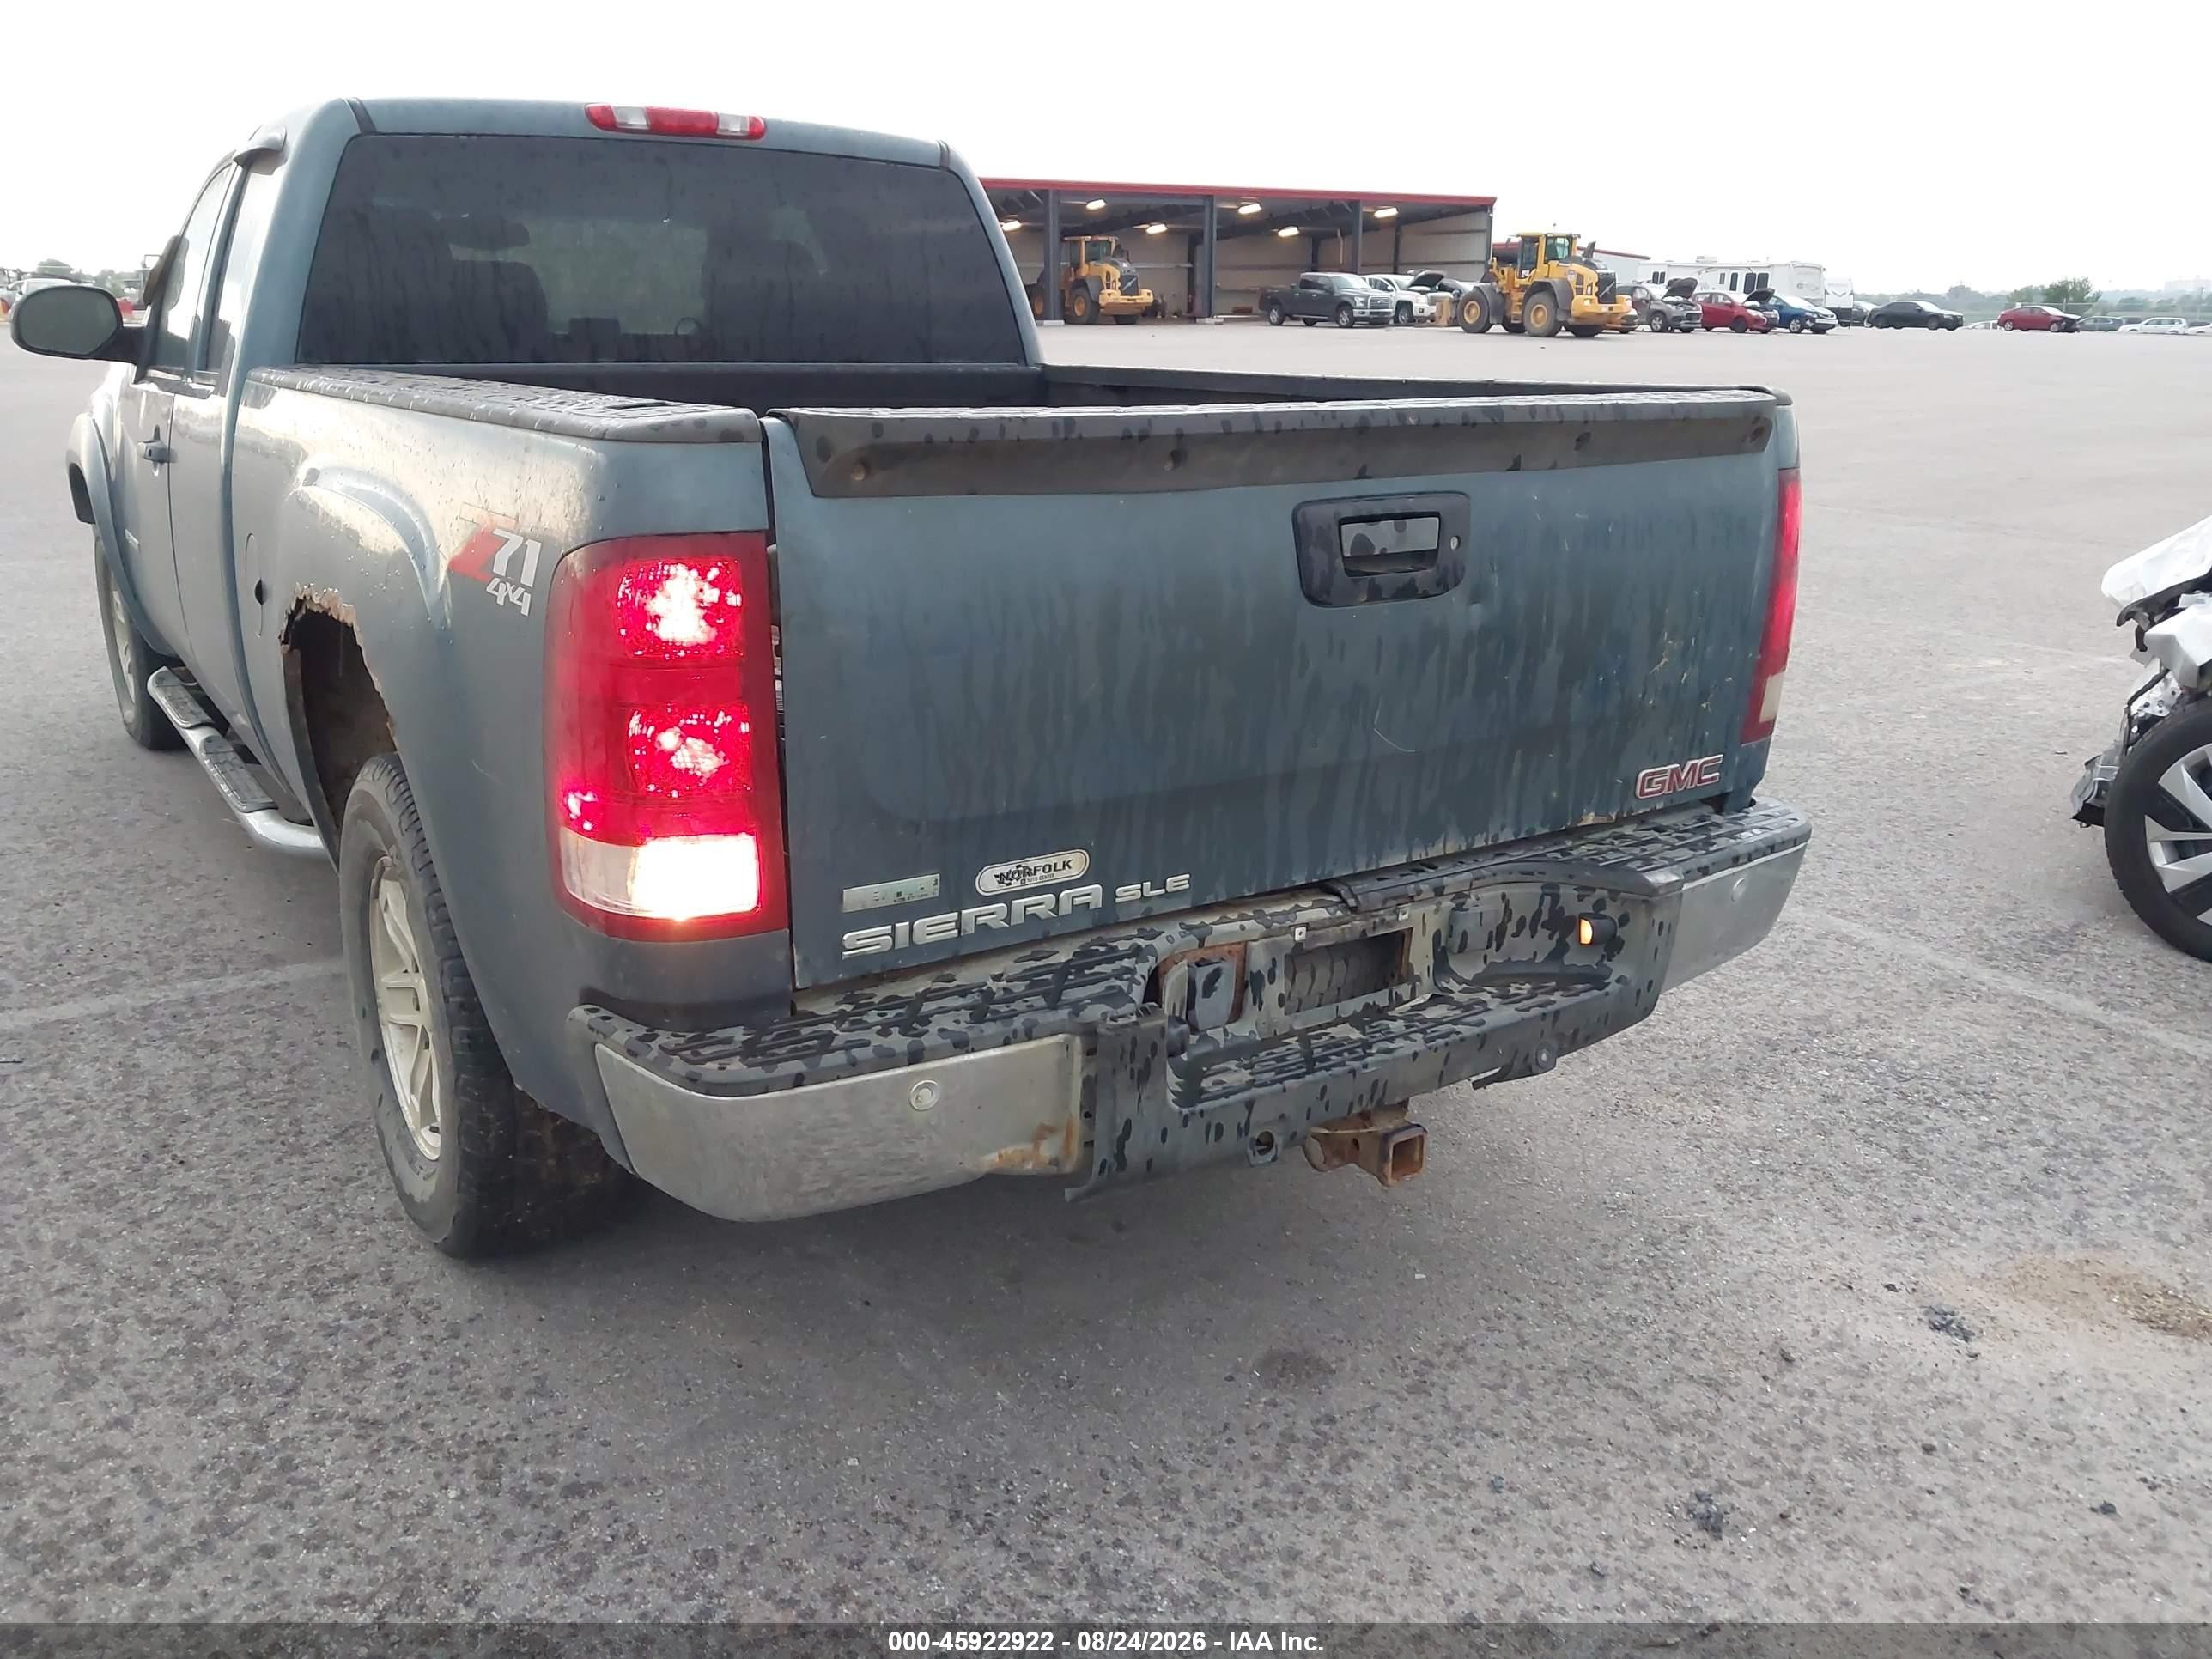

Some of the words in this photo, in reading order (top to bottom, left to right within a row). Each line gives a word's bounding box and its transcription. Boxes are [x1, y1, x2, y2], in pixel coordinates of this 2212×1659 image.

[1635, 754, 1724, 799] GMC
[998, 859, 1073, 882] NORFOLK
[842, 884, 1103, 960] SIERRA
[1115, 873, 1191, 903] SLE
